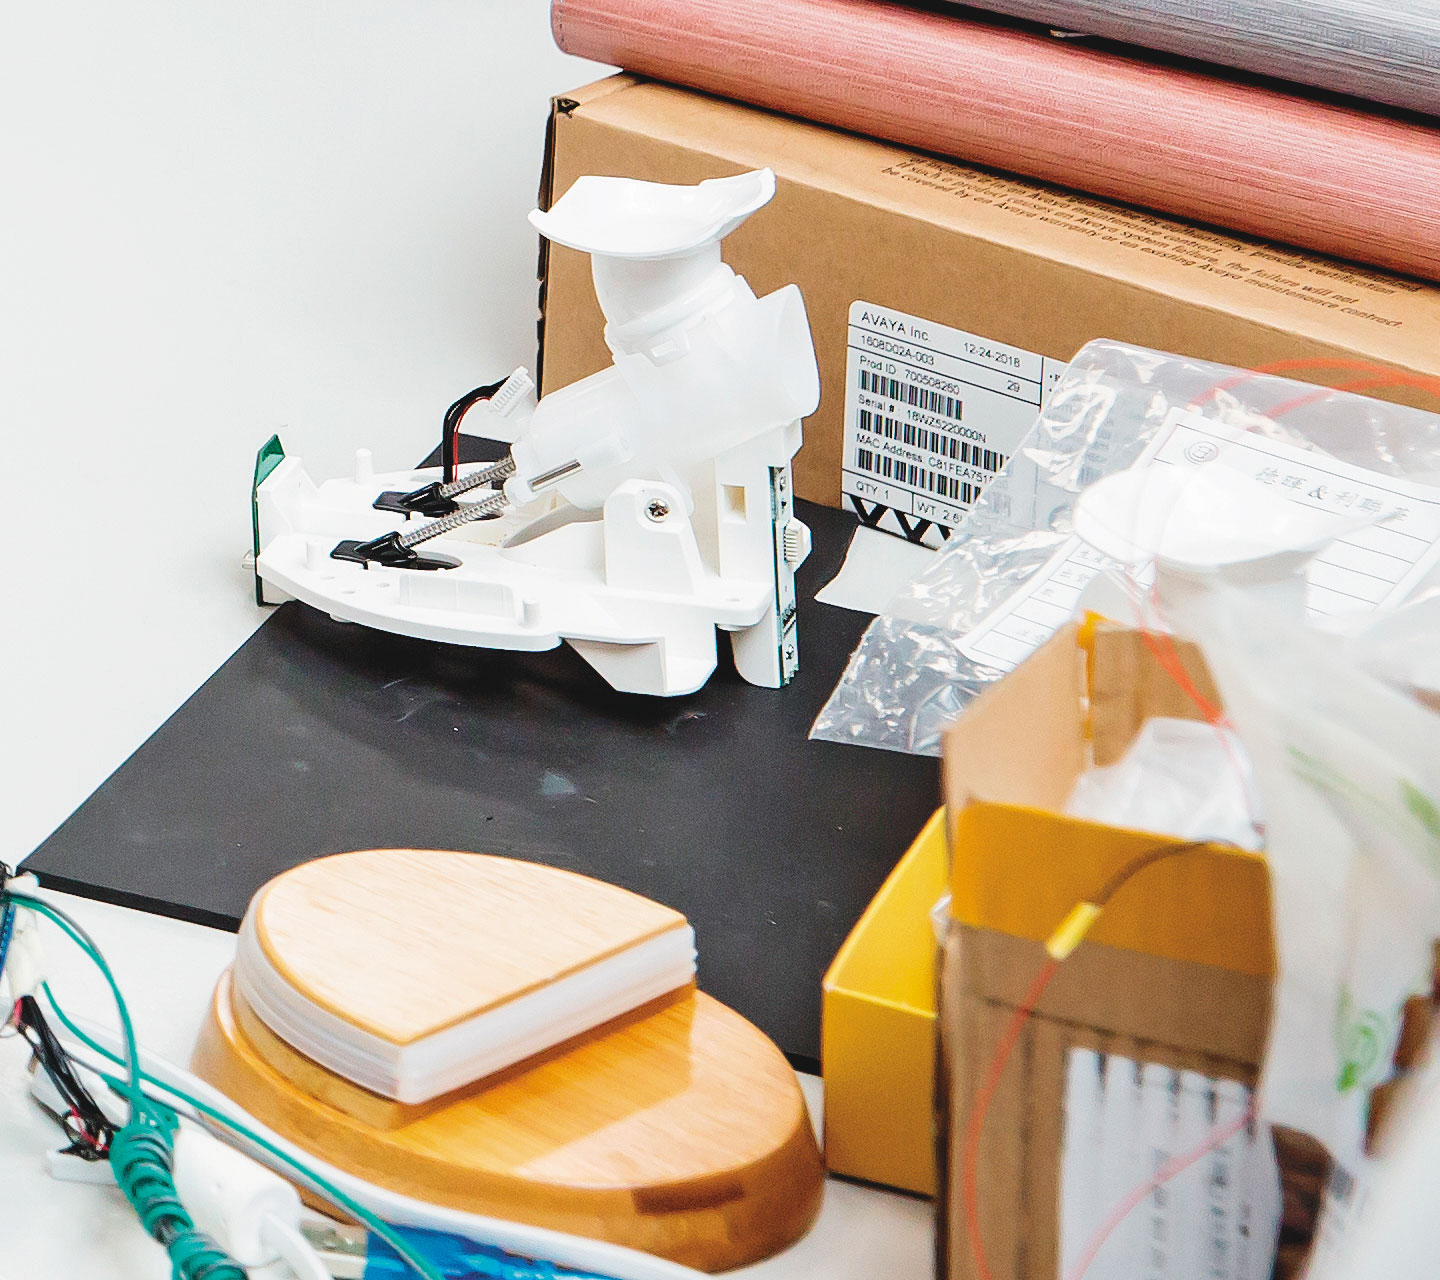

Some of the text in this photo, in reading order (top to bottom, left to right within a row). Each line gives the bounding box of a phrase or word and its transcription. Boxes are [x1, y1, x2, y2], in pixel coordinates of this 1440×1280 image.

[951, 187, 973, 199] by
[972, 195, 994, 204] an
[990, 199, 1040, 220] Avaya
[1036, 215, 1101, 237] warranty
[1099, 234, 1118, 243] or
[1117, 239, 1139, 249] an
[1137, 245, 1198, 267] existing
[1194, 261, 1246, 282] Avaya
[1241, 276, 1341, 309] maintenance
[1072, 214, 1122, 234] Avaya
[1119, 230, 1171, 249] system
[1224, 260, 1252, 273] the
[1249, 267, 1303, 288] failure
[1300, 283, 1333, 297] will
[1330, 292, 1360, 305] not
[861, 310, 906, 335] AVAYA
[859, 355, 883, 371] Prod
[964, 342, 1021, 368] 12-24-2018
[858, 393, 886, 413] Serial
[856, 432, 881, 450] MAC
